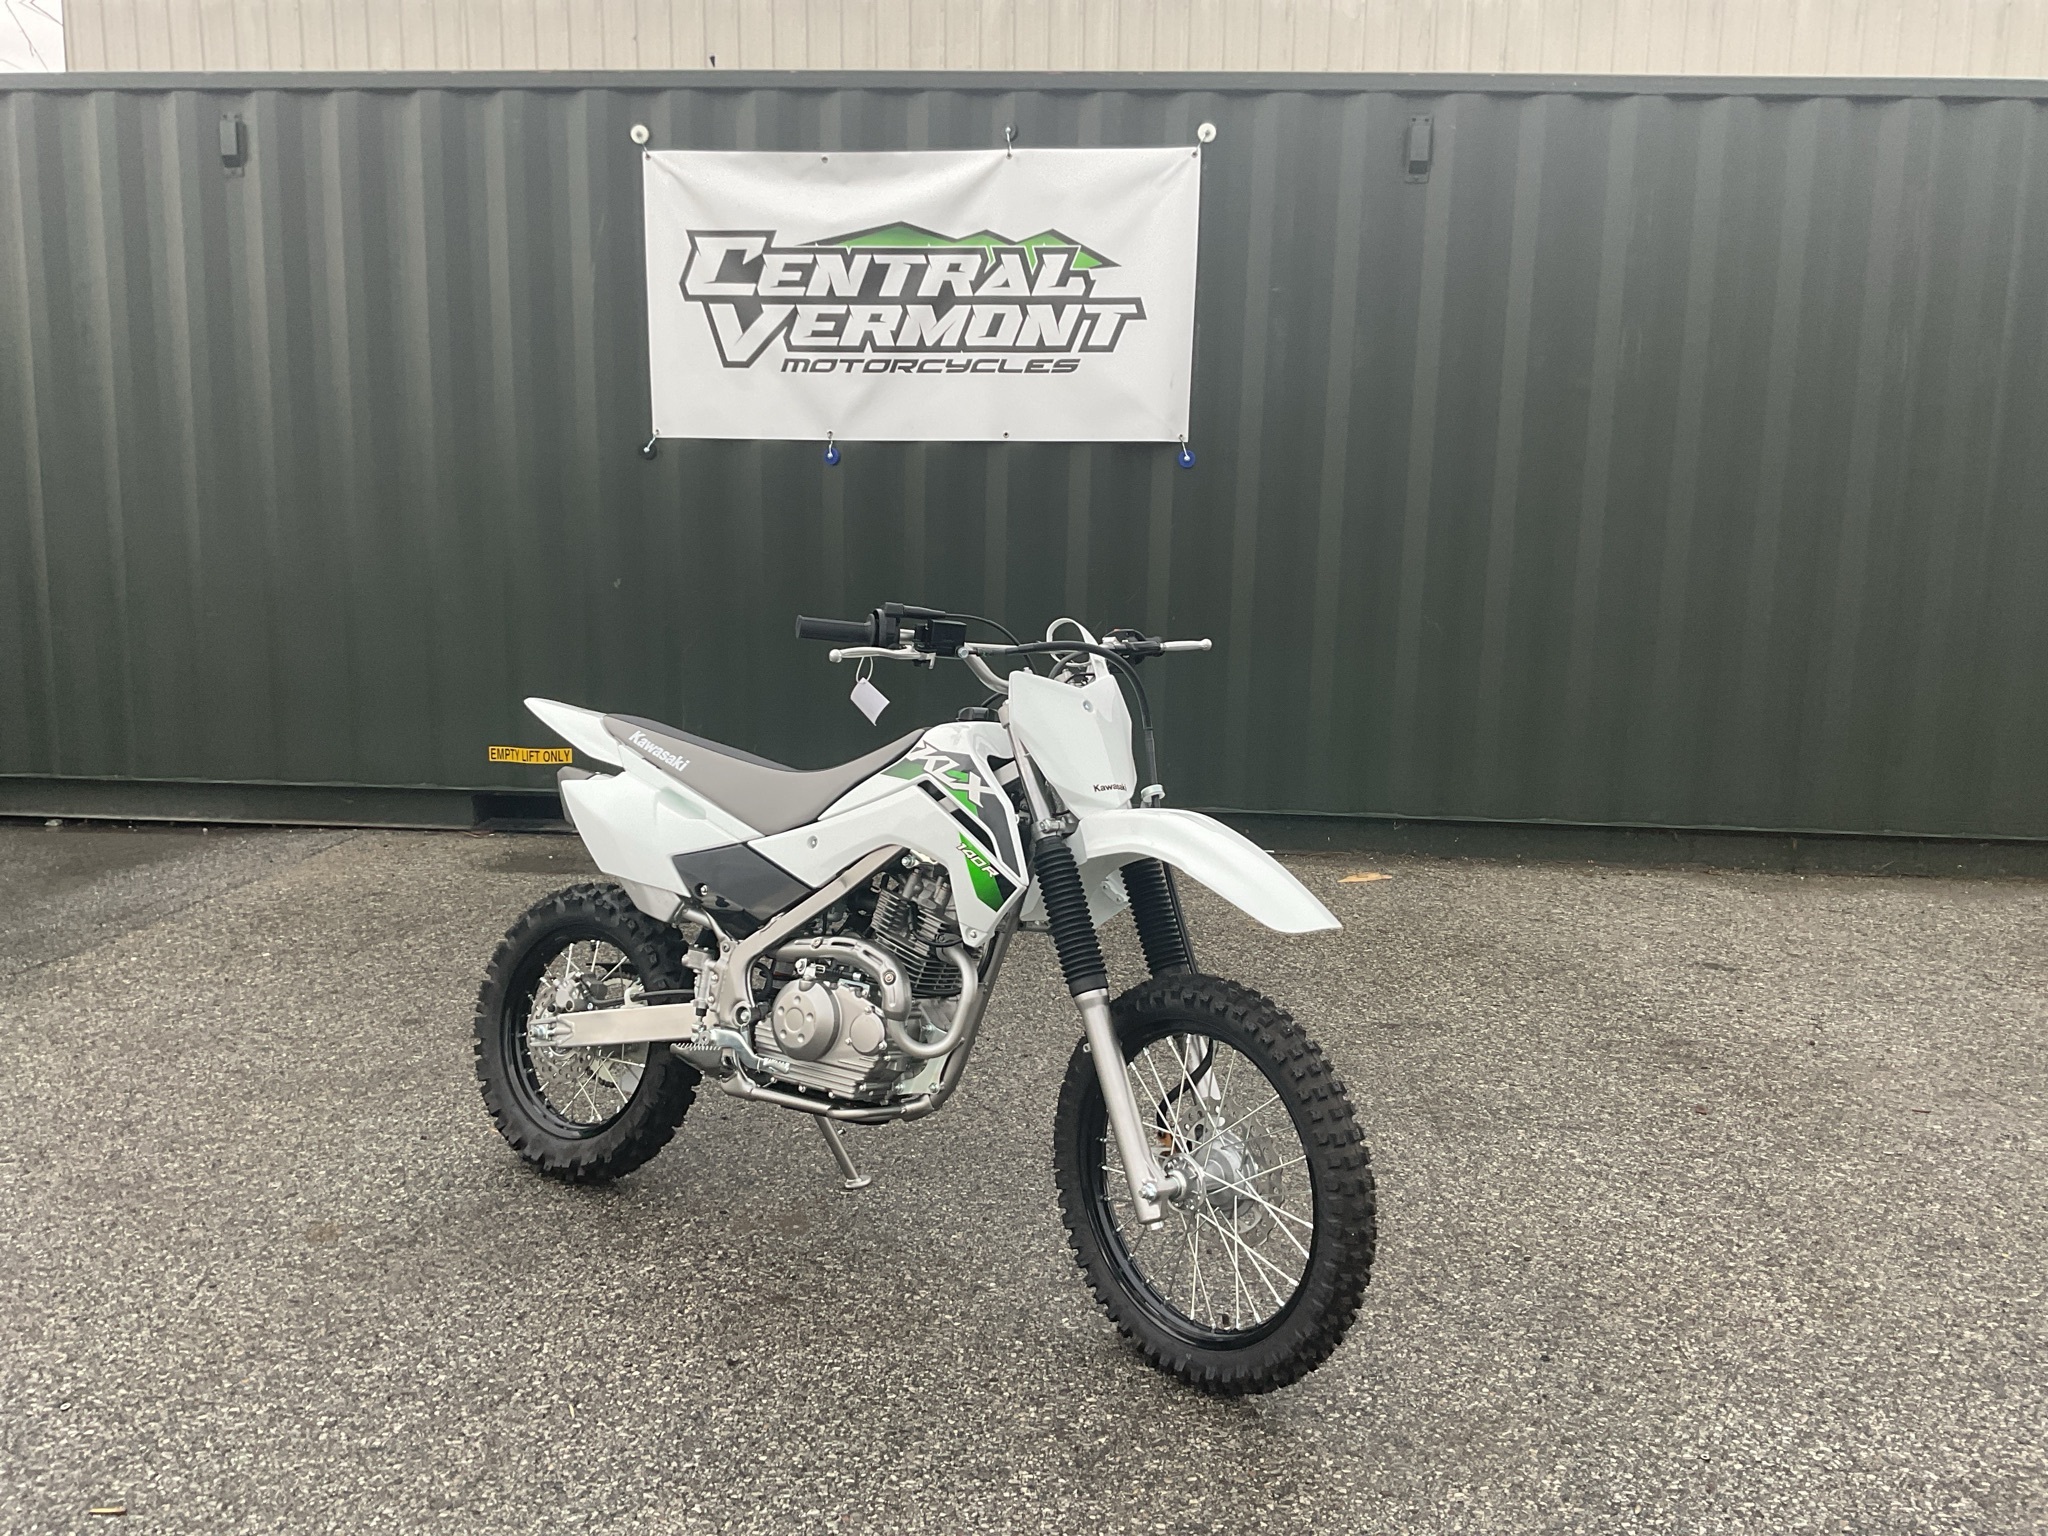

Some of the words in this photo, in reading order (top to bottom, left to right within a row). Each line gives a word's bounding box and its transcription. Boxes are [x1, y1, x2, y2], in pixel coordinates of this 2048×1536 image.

[684, 233, 1089, 298] CENTRAL
[706, 301, 1141, 365] VERMONT
[781, 357, 1080, 373] MOTORCYCLES
[491, 747, 519, 760] EMPTY
[522, 749, 540, 762] LIFT
[543, 750, 570, 762] ONLY
[628, 730, 690, 772] Kawasaki
[905, 740, 997, 808] KLX
